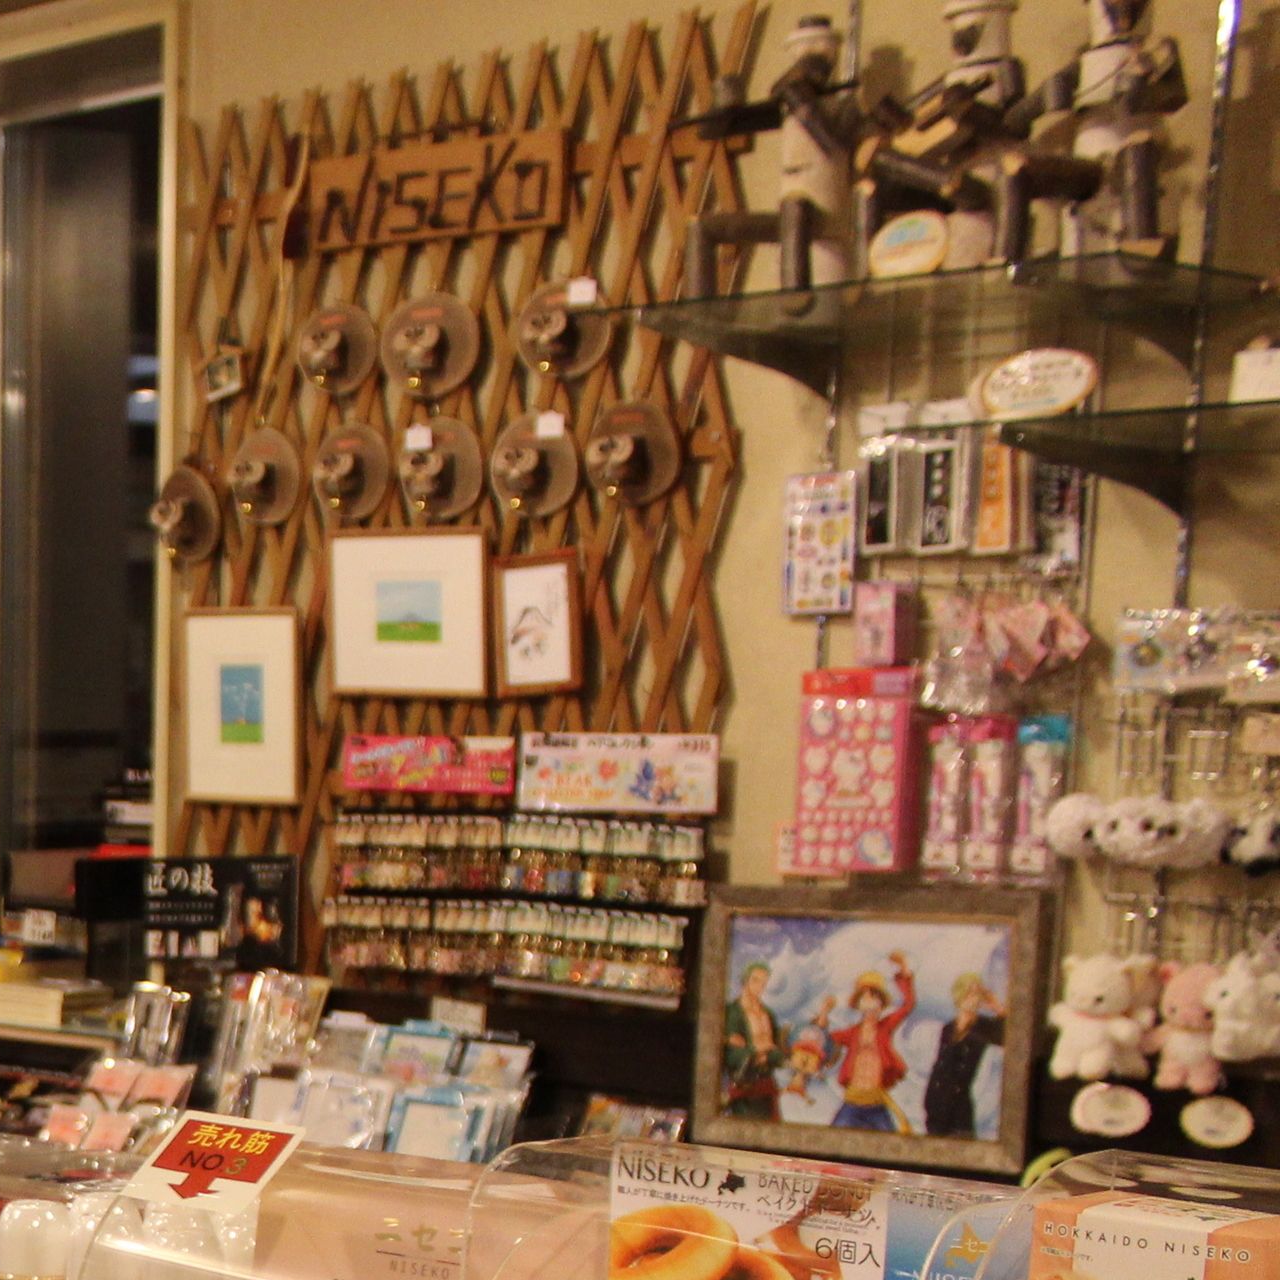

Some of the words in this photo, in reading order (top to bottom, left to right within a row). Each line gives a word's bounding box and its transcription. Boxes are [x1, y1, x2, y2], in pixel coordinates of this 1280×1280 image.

[318, 139, 549, 242] NISEKO
[187, 1123, 272, 1155] 売れ筋
[617, 1152, 711, 1190] NISEKO
[757, 1171, 814, 1194] BAKED
[815, 1236, 881, 1268] 6個入
[1043, 1222, 1148, 1249] HOKKAIDO
[1164, 1241, 1251, 1263] NISEKO
[389, 1259, 450, 1280] NISEKO
